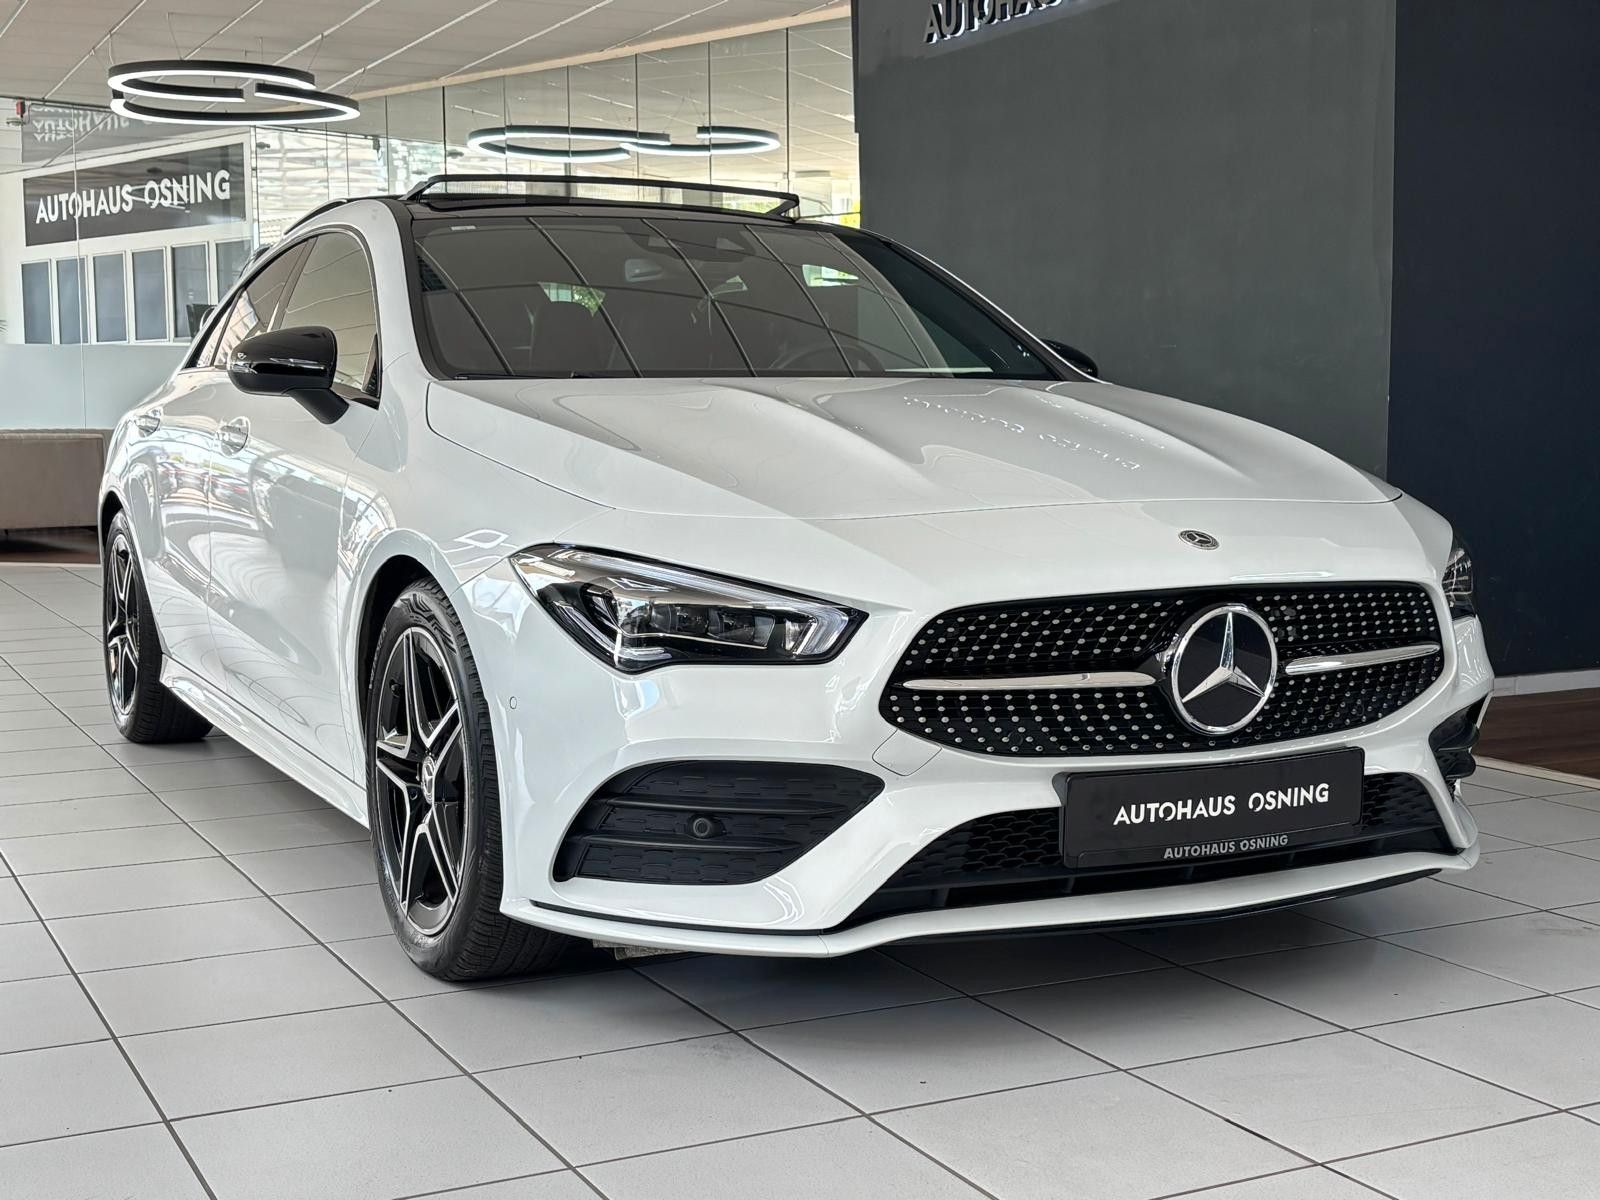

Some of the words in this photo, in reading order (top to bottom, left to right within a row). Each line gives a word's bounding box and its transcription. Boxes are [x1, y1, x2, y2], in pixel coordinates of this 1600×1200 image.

[36, 184, 133, 224] AUTOHAUS
[144, 169, 231, 209] OSNING
[1113, 795, 1236, 825] AUTOHAUS
[1248, 783, 1329, 812] OSNING
[1163, 842, 1236, 859] AUTOHAUS
[1239, 834, 1289, 851] OSNING
